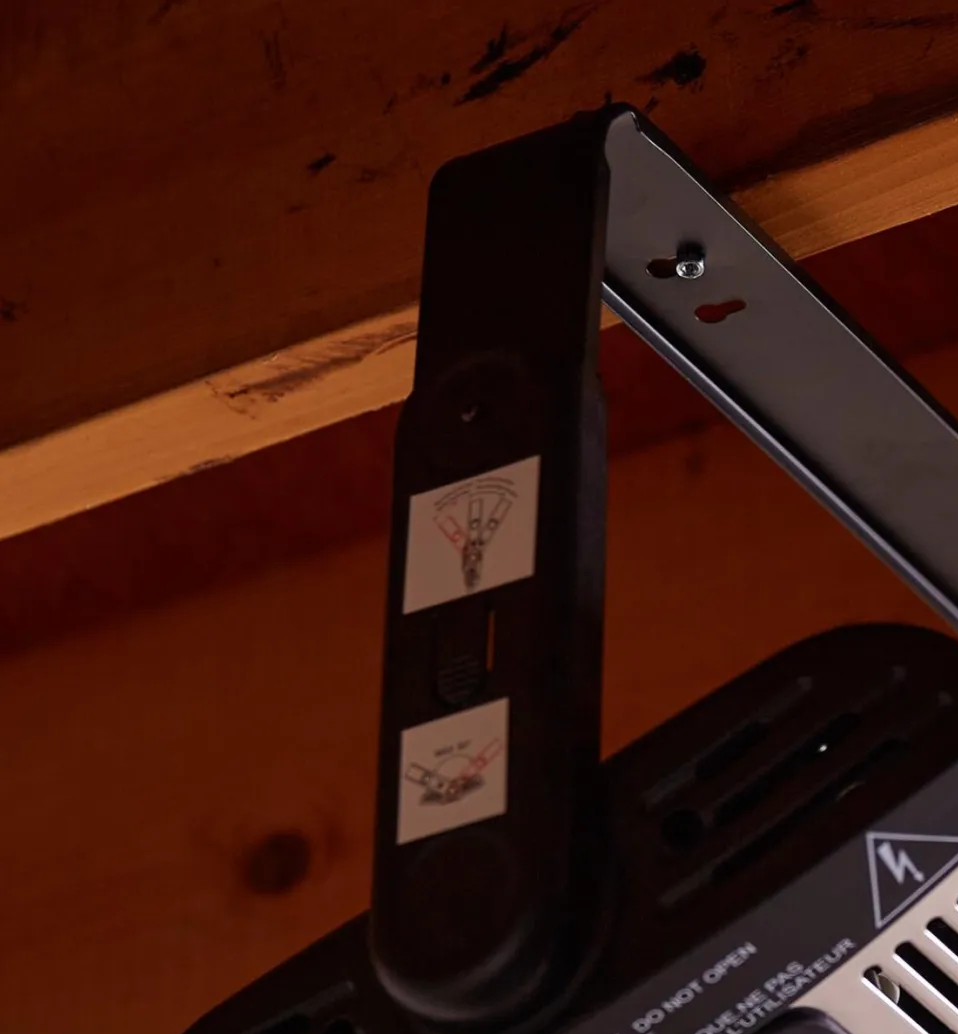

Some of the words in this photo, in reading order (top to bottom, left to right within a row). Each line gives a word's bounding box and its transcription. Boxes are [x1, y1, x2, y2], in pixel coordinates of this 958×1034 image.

[632, 1008, 665, 1033] DO
[661, 979, 703, 1012] NOT
[702, 941, 757, 984] OPEN
[736, 988, 769, 1012] NE
[764, 961, 803, 993] PAS
